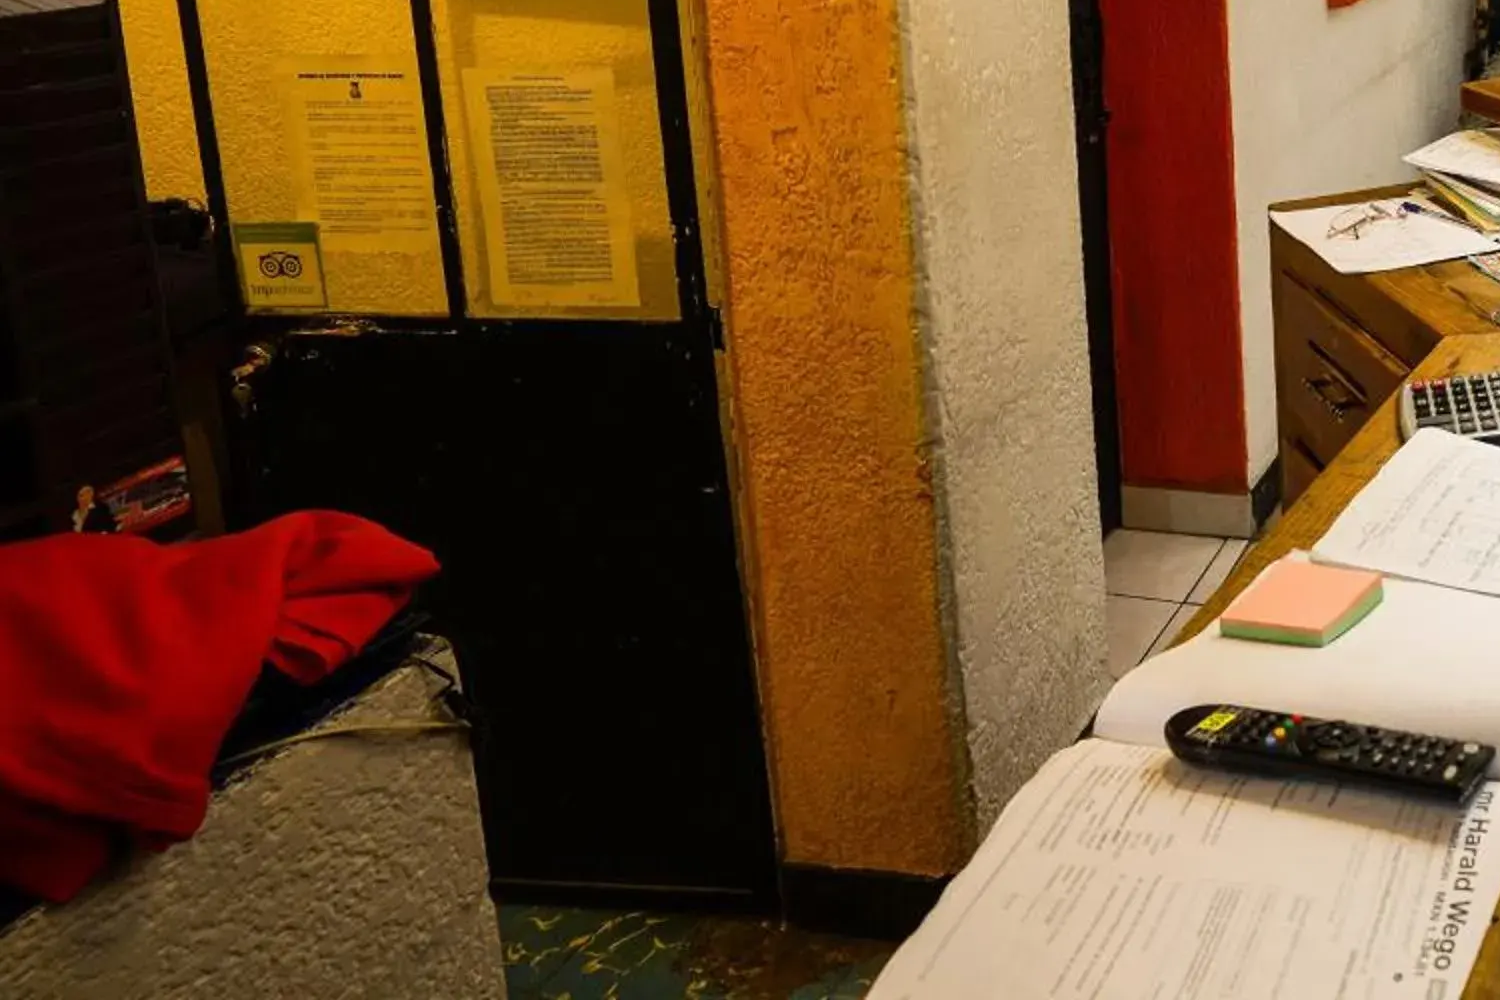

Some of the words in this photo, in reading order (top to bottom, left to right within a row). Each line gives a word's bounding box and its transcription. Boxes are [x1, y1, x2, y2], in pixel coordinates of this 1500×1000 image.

[1476, 790, 1494, 813] mr
[1454, 818, 1491, 893] Harald
[1433, 899, 1473, 971] Wego
